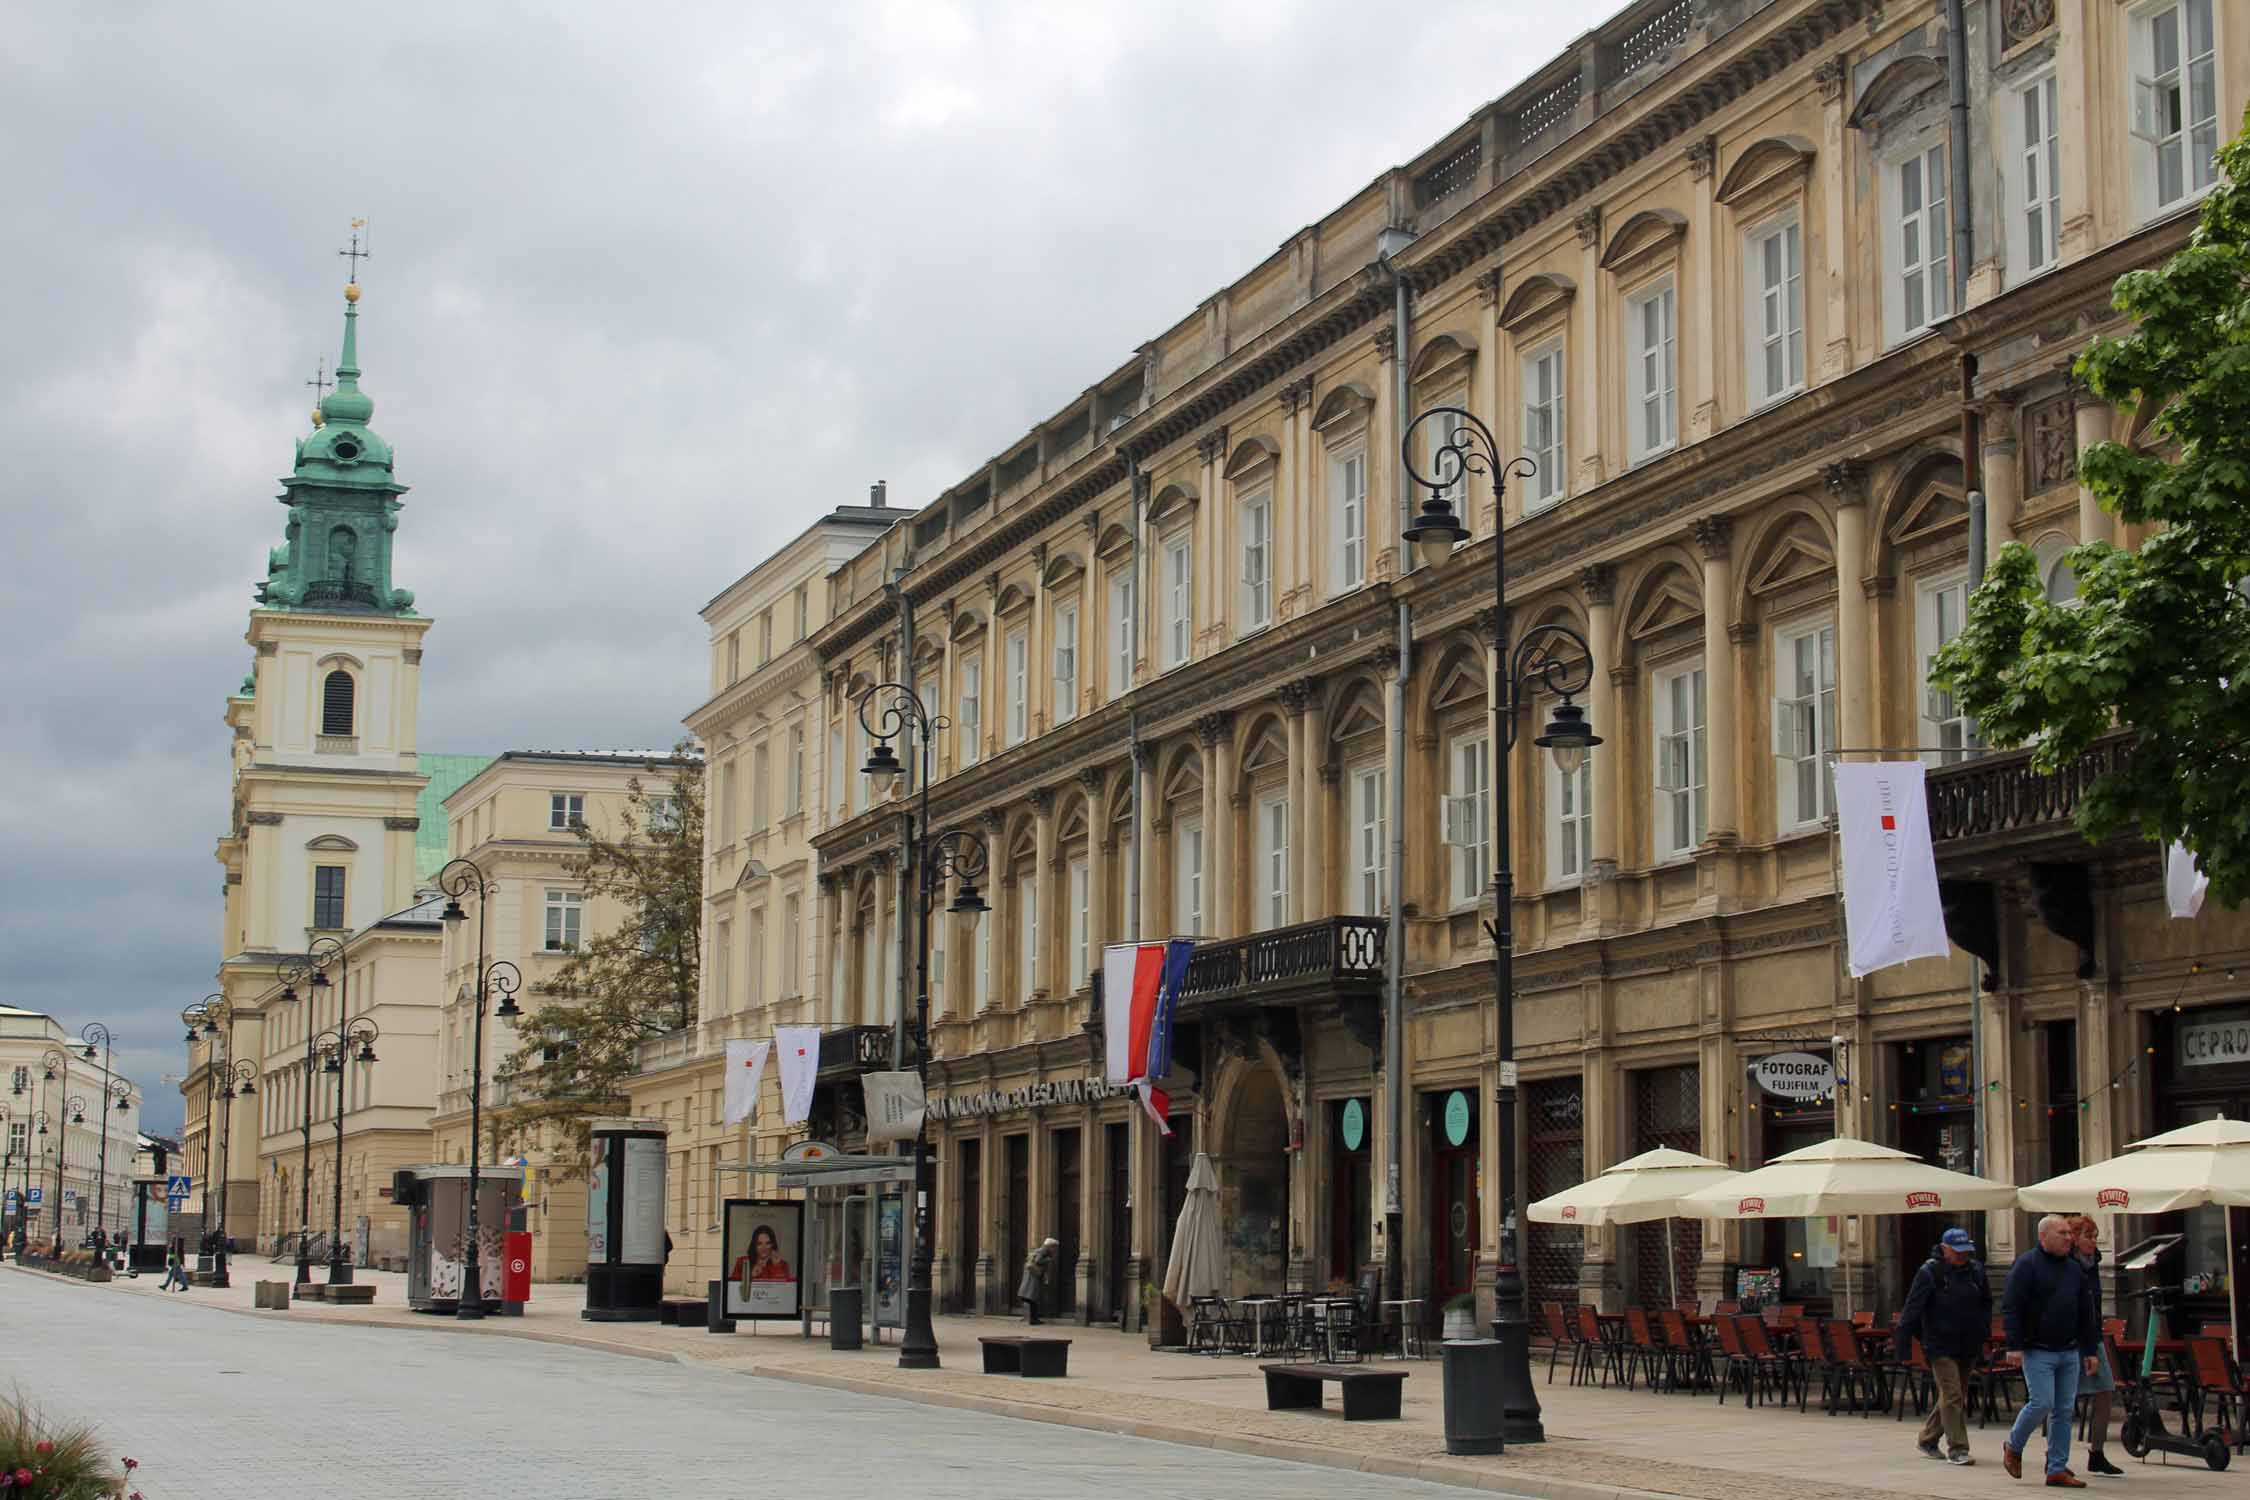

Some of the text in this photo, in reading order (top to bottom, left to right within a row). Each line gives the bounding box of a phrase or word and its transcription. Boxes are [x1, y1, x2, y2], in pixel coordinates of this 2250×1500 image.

[2185, 1028, 2250, 1059] CEPRO
[1762, 1062, 1829, 1076] FOTOGRAF
[1772, 1080, 1819, 1091] FUJIFILM
[8, 1191, 15, 1200] P
[31, 1190, 40, 1200] P
